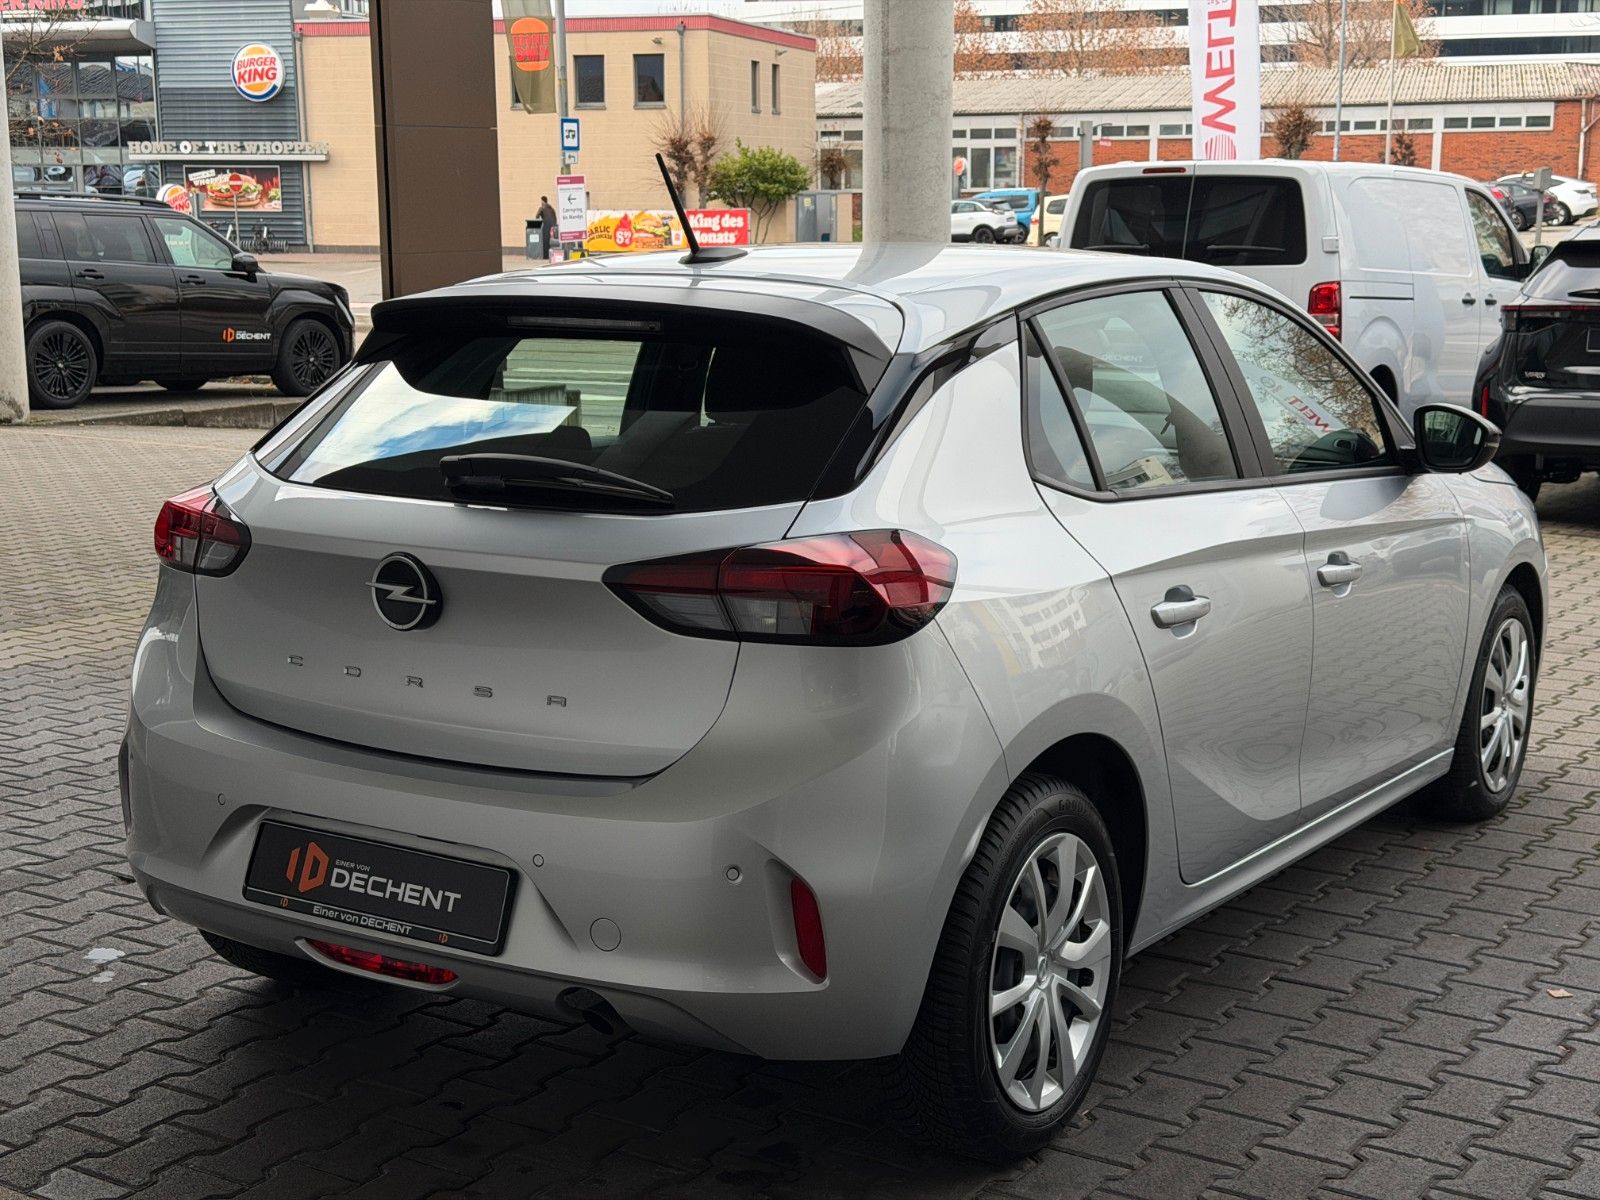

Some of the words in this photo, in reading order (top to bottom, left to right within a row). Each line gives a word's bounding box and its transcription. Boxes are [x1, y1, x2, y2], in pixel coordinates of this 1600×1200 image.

[237, 56, 277, 71] BURGER
[237, 67, 278, 85] KING
[127, 141, 177, 154] HOME
[180, 140, 202, 154] OF
[205, 141, 241, 154] THE
[243, 141, 327, 154] WHOPPER
[689, 213, 720, 231] King
[721, 213, 744, 228] des
[287, 654, 567, 708] CORSA
[335, 859, 355, 869] EINER
[356, 863, 371, 872] VON
[330, 867, 462, 913] DECHENT
[313, 905, 340, 919] Einer
[340, 912, 359, 925] von
[360, 916, 412, 935] DECHENT
